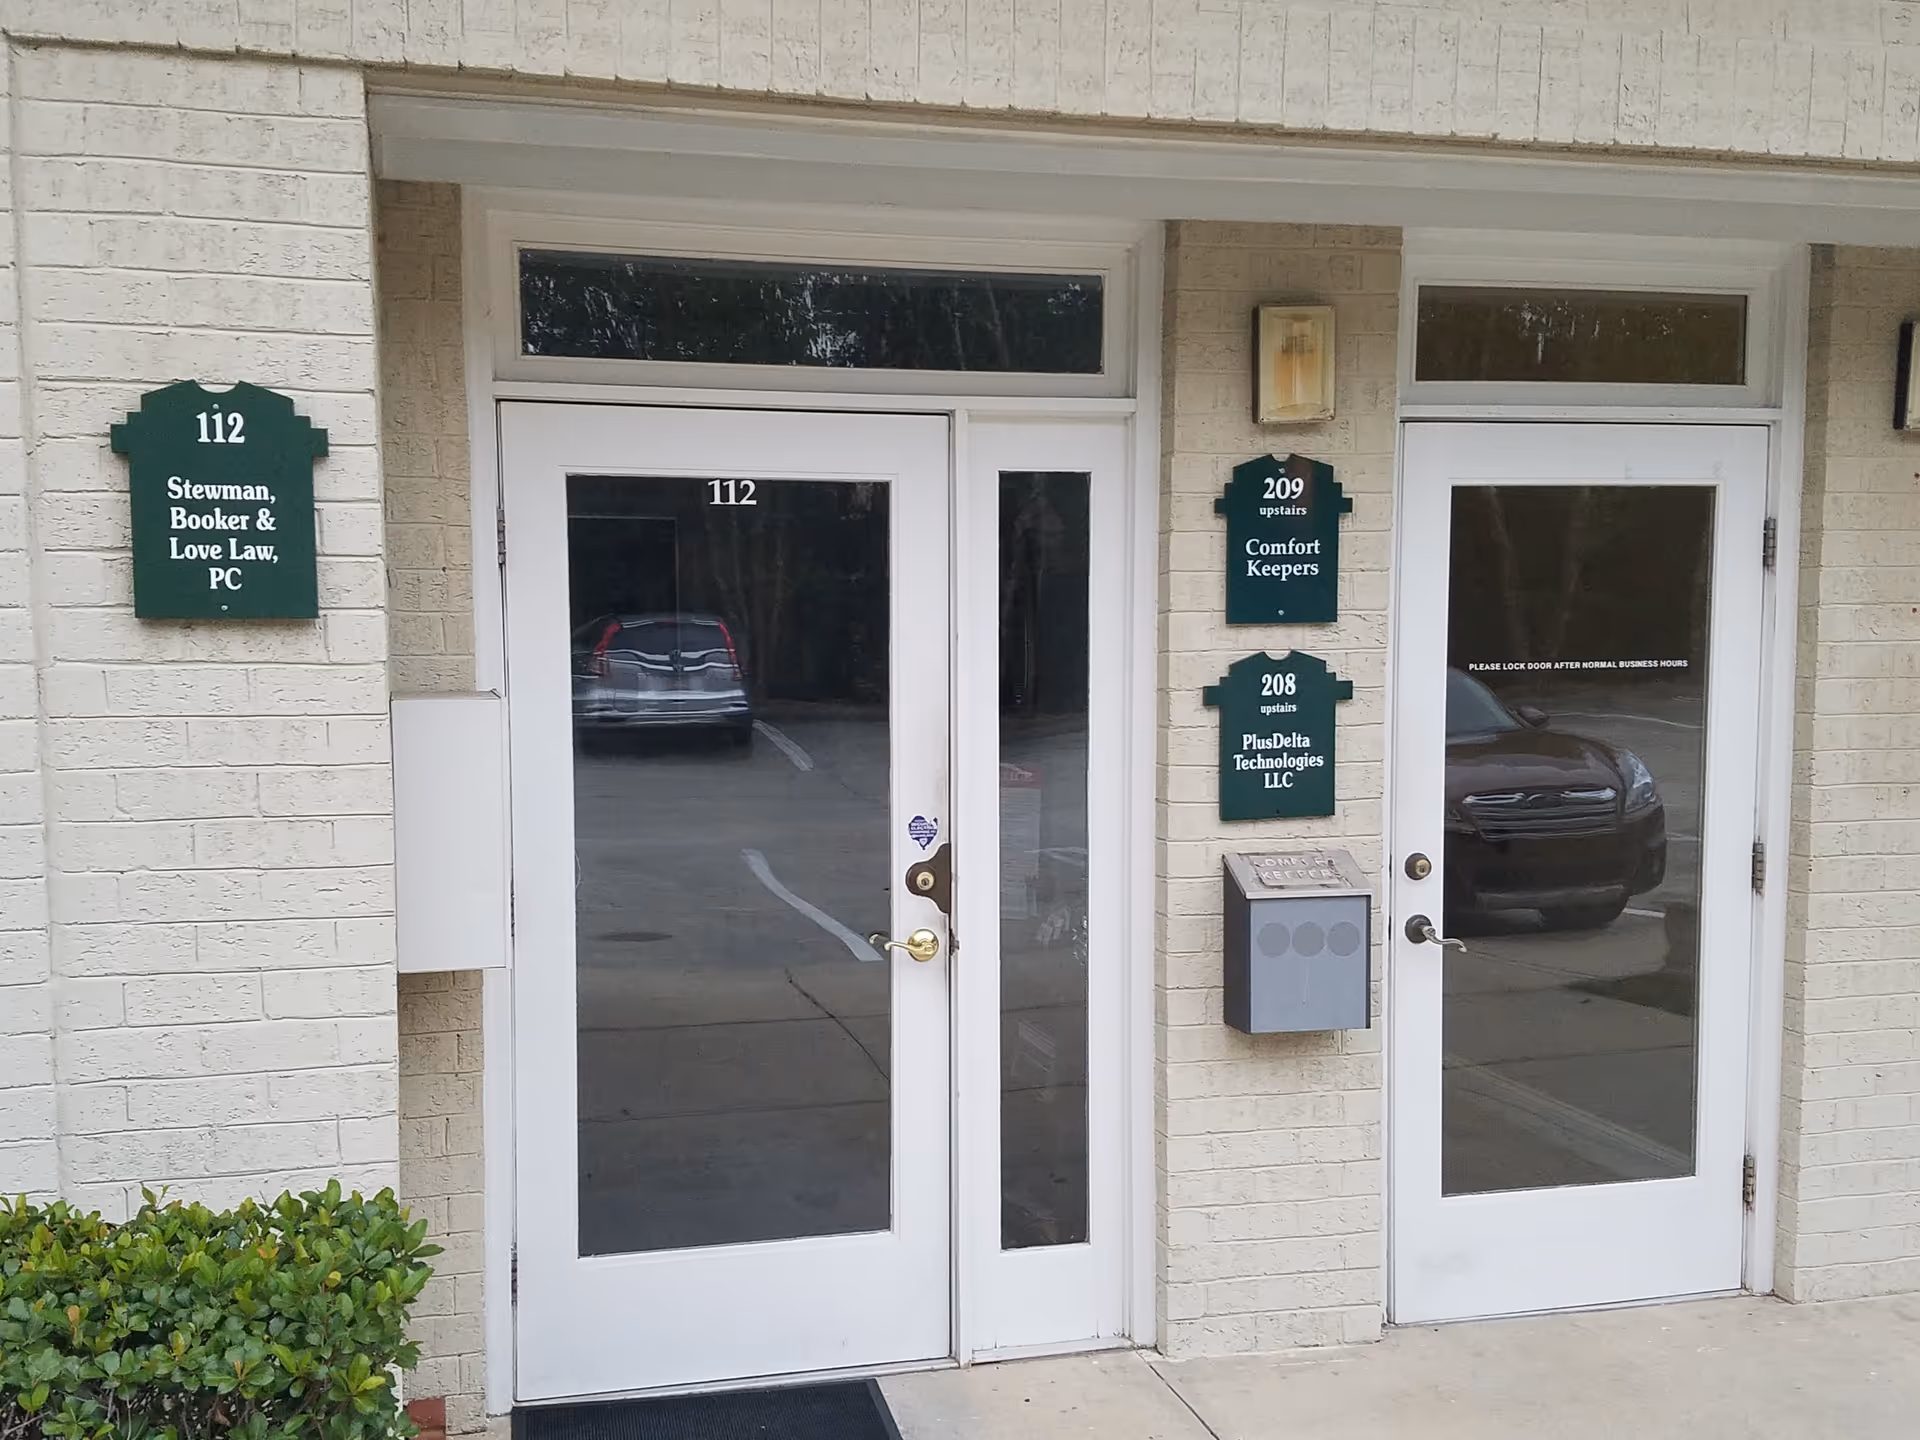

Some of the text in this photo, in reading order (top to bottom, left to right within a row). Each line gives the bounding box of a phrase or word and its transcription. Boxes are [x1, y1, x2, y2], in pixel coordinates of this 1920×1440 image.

[196, 411, 246, 444] 112
[167, 475, 276, 505] Stewman,
[707, 478, 758, 506] 112
[1262, 477, 1305, 500] 209
[169, 506, 277, 531] Booker &
[1259, 504, 1307, 519] upstairs
[169, 536, 279, 563] Love Law,
[1245, 537, 1321, 556] Comfort
[208, 567, 243, 590] PC
[1246, 559, 1319, 582] Keepers
[1468, 659, 1689, 671] PLEASE LOCK DOOR AFTER NORMAL BUSINESS HOURS
[1261, 672, 1297, 696] 208
[1260, 702, 1297, 716] upstairs
[1242, 731, 1311, 751] PlusDelta
[1233, 752, 1325, 772] Technologies
[1264, 771, 1294, 789] LLC
